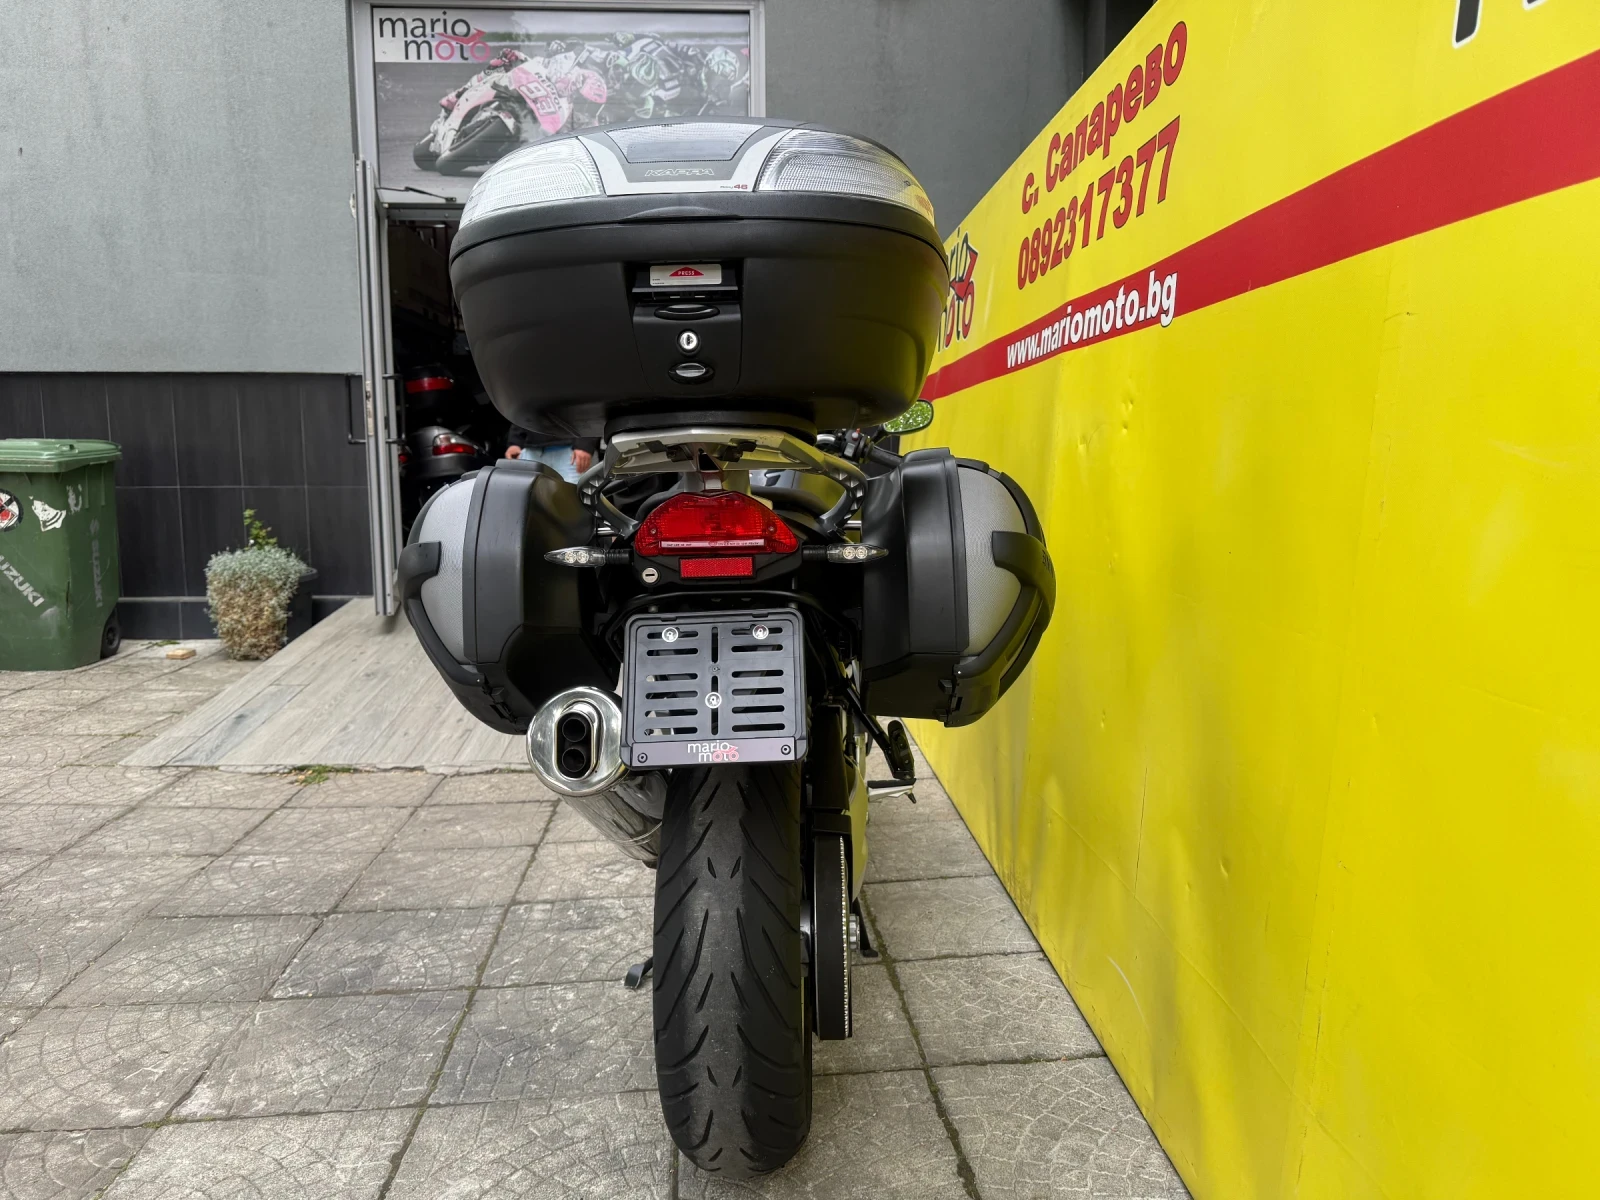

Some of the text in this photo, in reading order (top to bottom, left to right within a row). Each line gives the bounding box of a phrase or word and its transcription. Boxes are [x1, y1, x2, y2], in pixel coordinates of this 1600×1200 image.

[379, 10, 471, 38] mario
[404, 40, 490, 61] moto
[1046, 20, 1188, 193] Сапарево
[644, 168, 714, 176] KAPPA
[1017, 115, 1181, 291] 0892317377
[1006, 270, 1178, 369] www.mariomoto.bg
[687, 740, 730, 753] mario
[698, 751, 740, 762] moto
